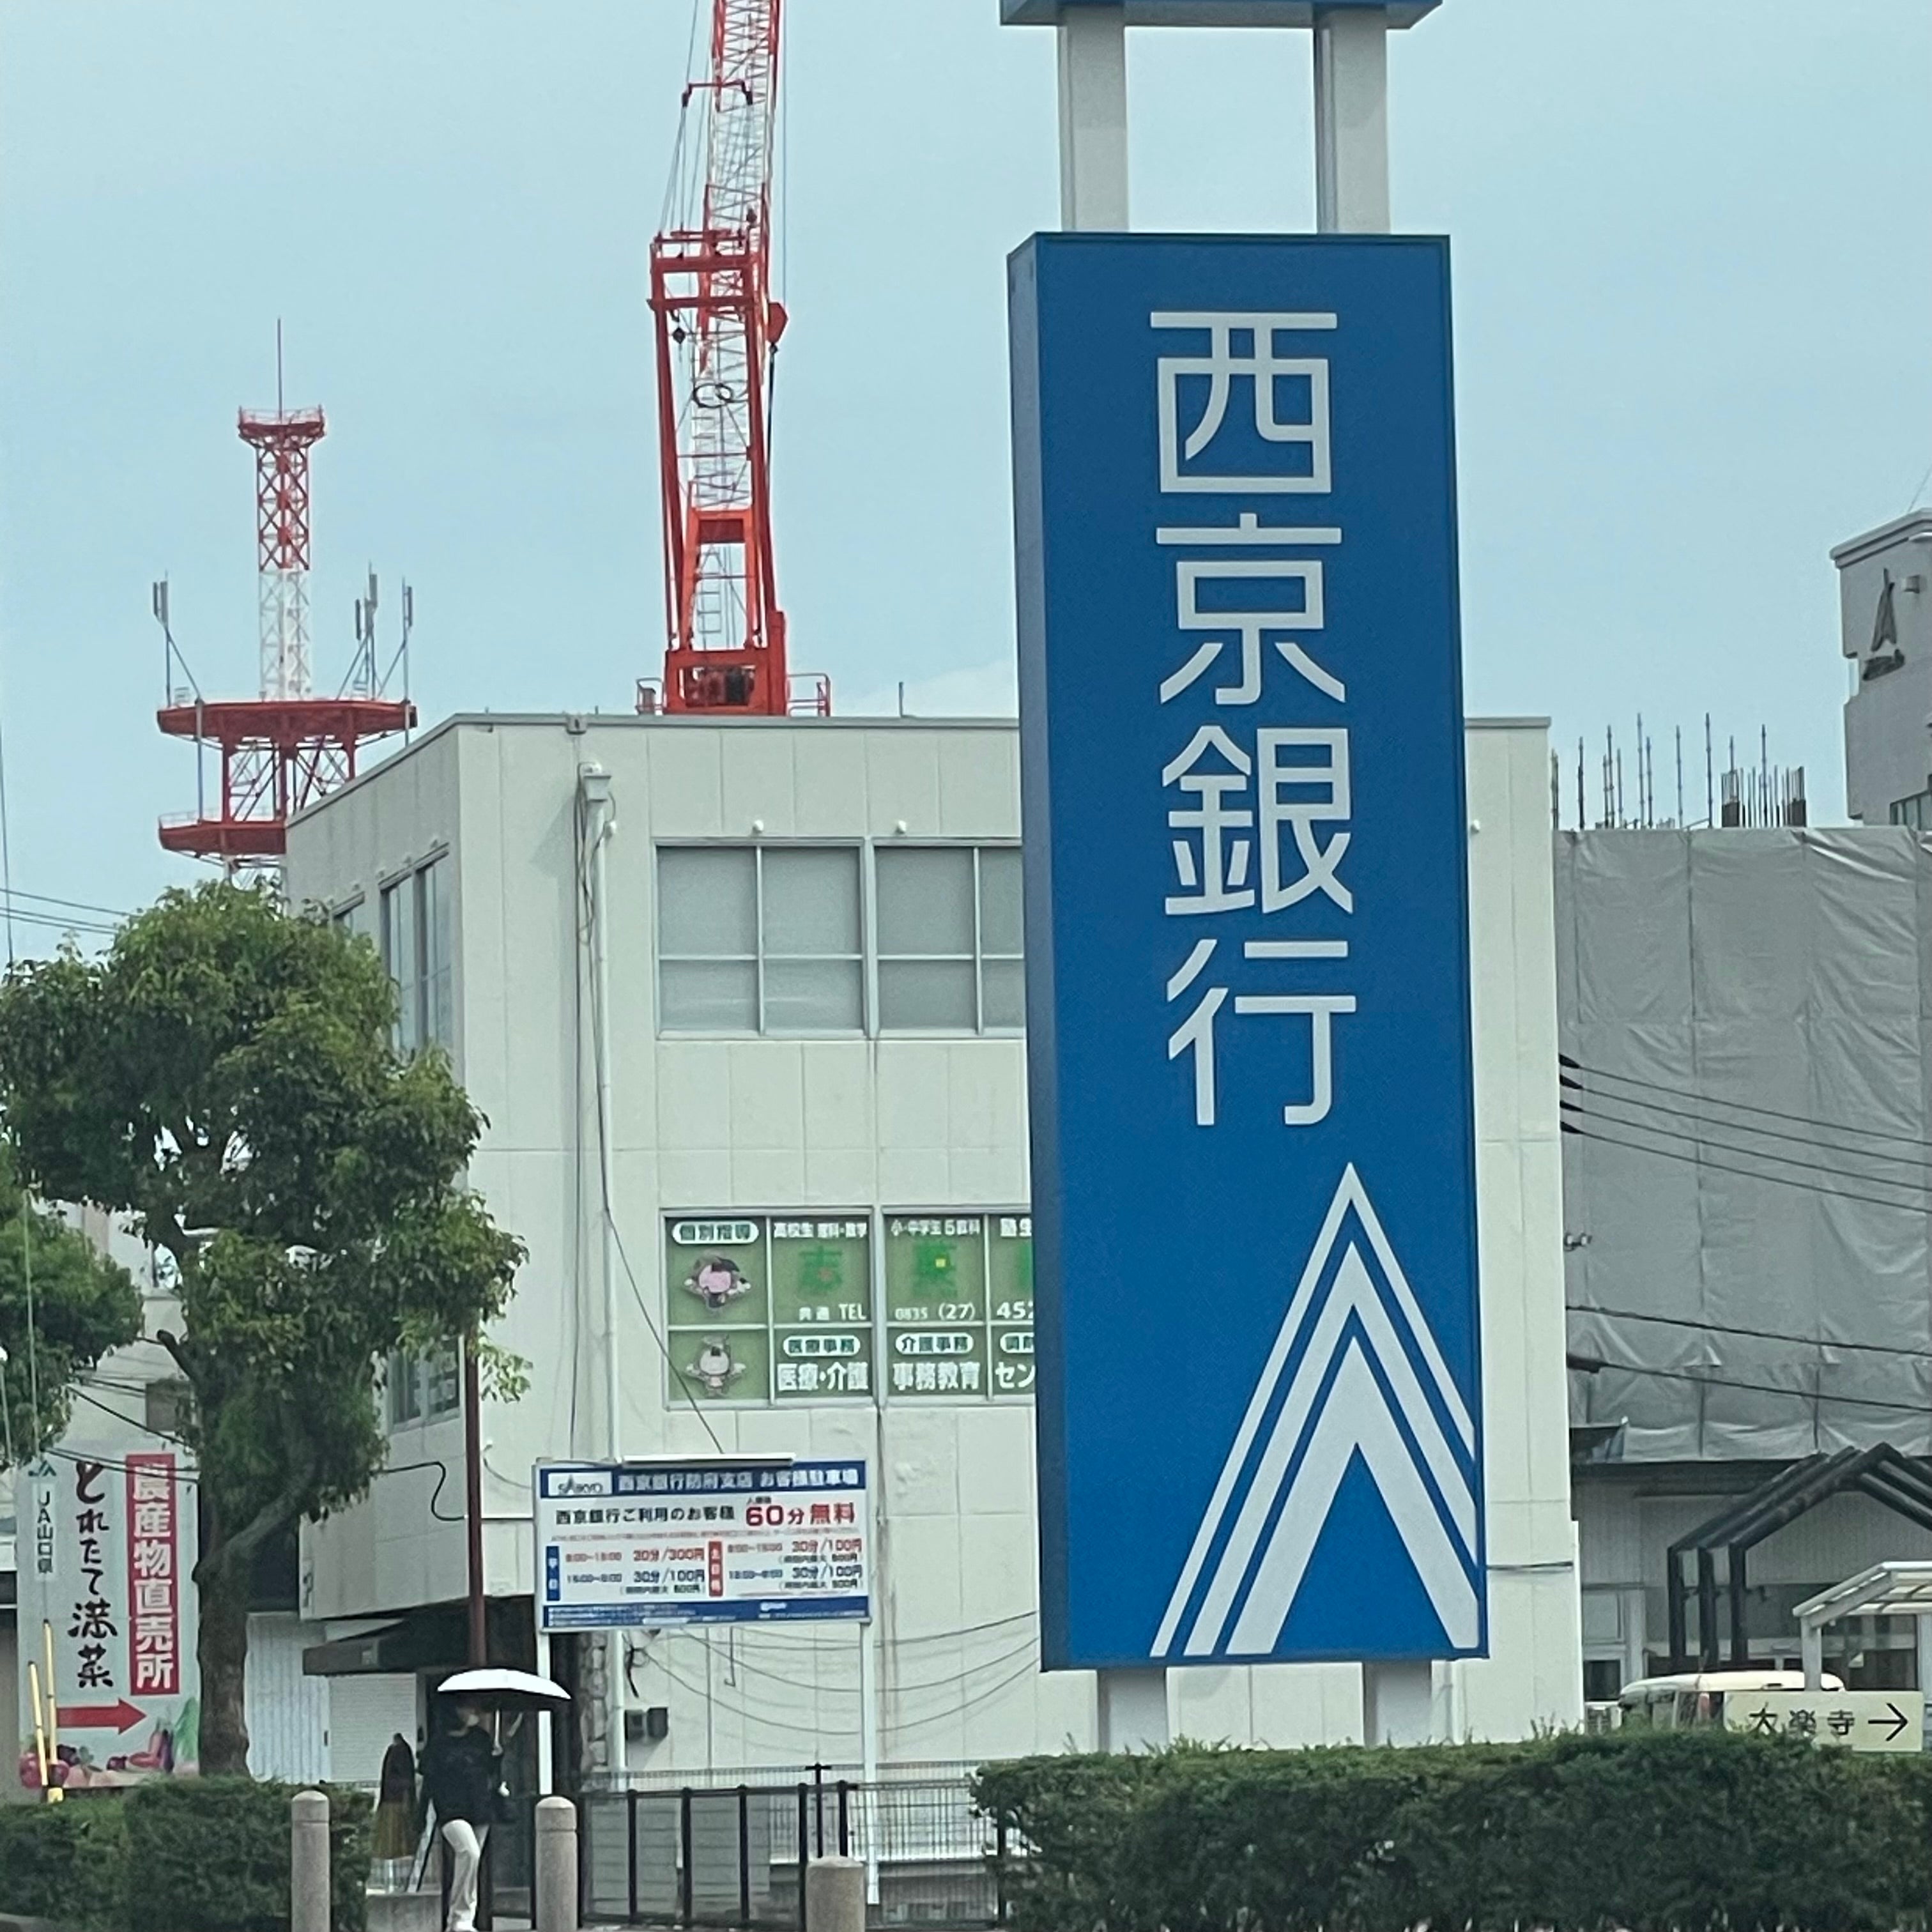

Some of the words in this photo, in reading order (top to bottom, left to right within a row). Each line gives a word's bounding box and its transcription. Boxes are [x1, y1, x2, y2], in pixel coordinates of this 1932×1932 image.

[1149, 310, 1358, 1126] 西京銀行
[839, 1303, 868, 1320] TEL
[938, 1302, 976, 1321] (27)
[777, 1361, 869, 1391] 医療・介護
[893, 1361, 981, 1390] 事務教育
[555, 1505, 735, 1525] 西京銀行ご利用のお客様
[746, 1502, 855, 1527] 60分無料
[68, 1460, 118, 1688] とれたて満菜
[134, 1463, 173, 1690] 農産物直売所
[1748, 1707, 1855, 1736] 大楽寺
